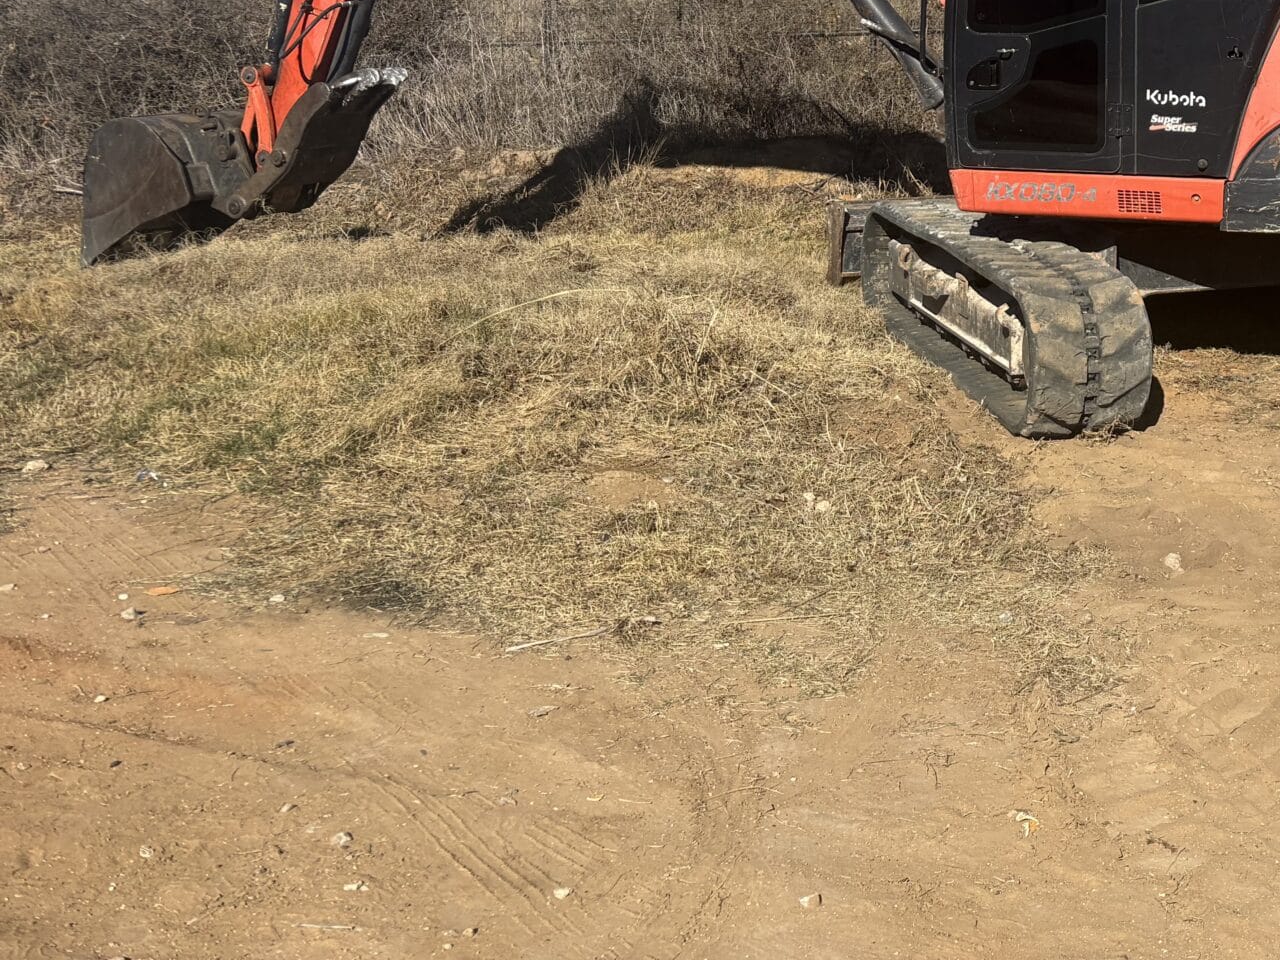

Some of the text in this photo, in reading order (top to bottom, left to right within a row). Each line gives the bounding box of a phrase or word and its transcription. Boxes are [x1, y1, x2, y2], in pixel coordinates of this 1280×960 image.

[1146, 89, 1206, 107] Kubota
[1150, 114, 1182, 125] Super
[1164, 122, 1198, 132] Series
[986, 182, 1097, 202] KX080-4
